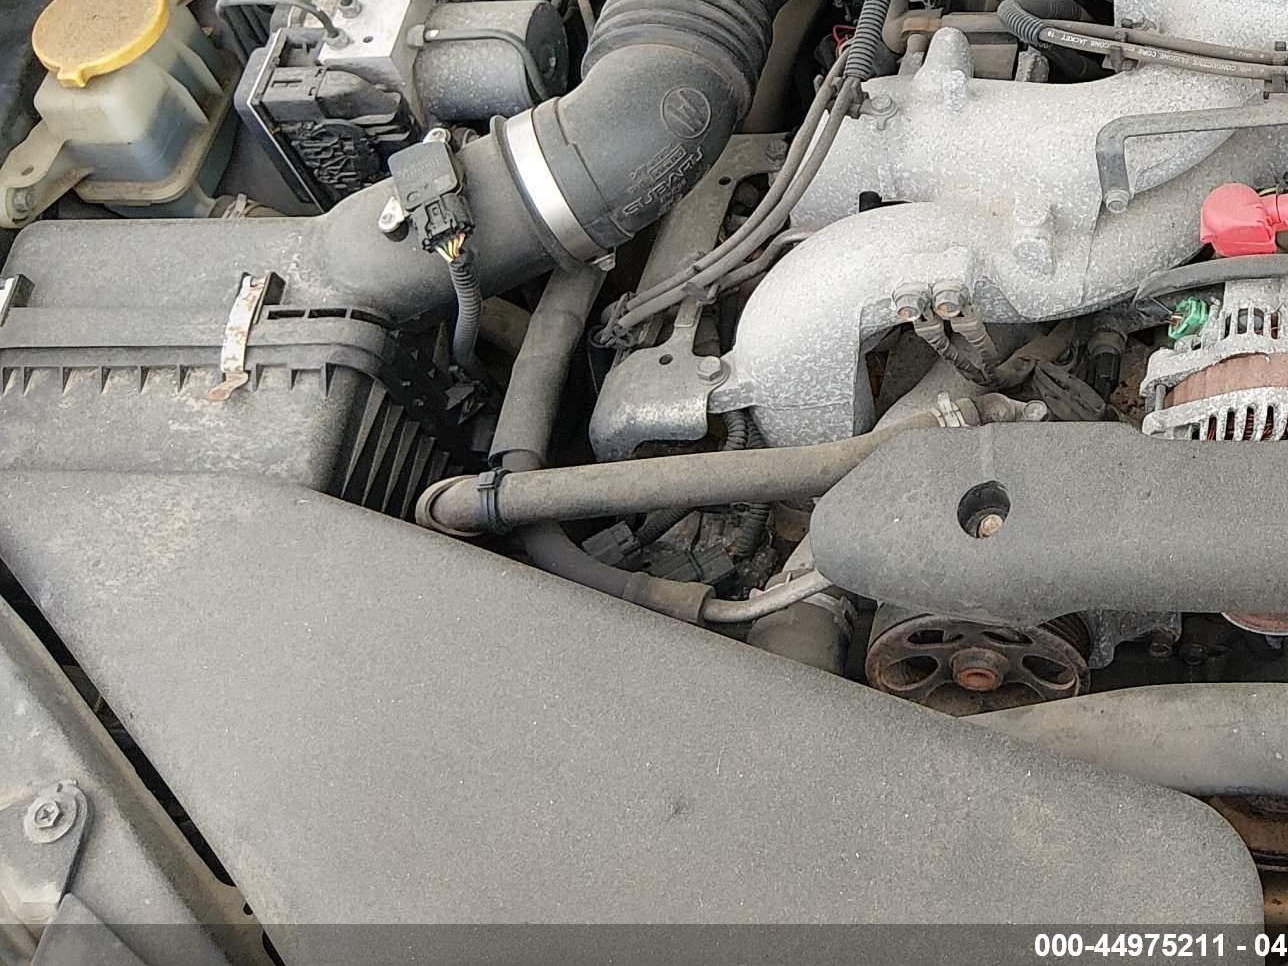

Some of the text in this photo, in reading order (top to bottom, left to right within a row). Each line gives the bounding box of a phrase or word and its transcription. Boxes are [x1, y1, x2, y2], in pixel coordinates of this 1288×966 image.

[1060, 33, 1088, 46] JACKET
[1139, 48, 1158, 58] CORE
[1191, 56, 1237, 72] CONDUCTIVE
